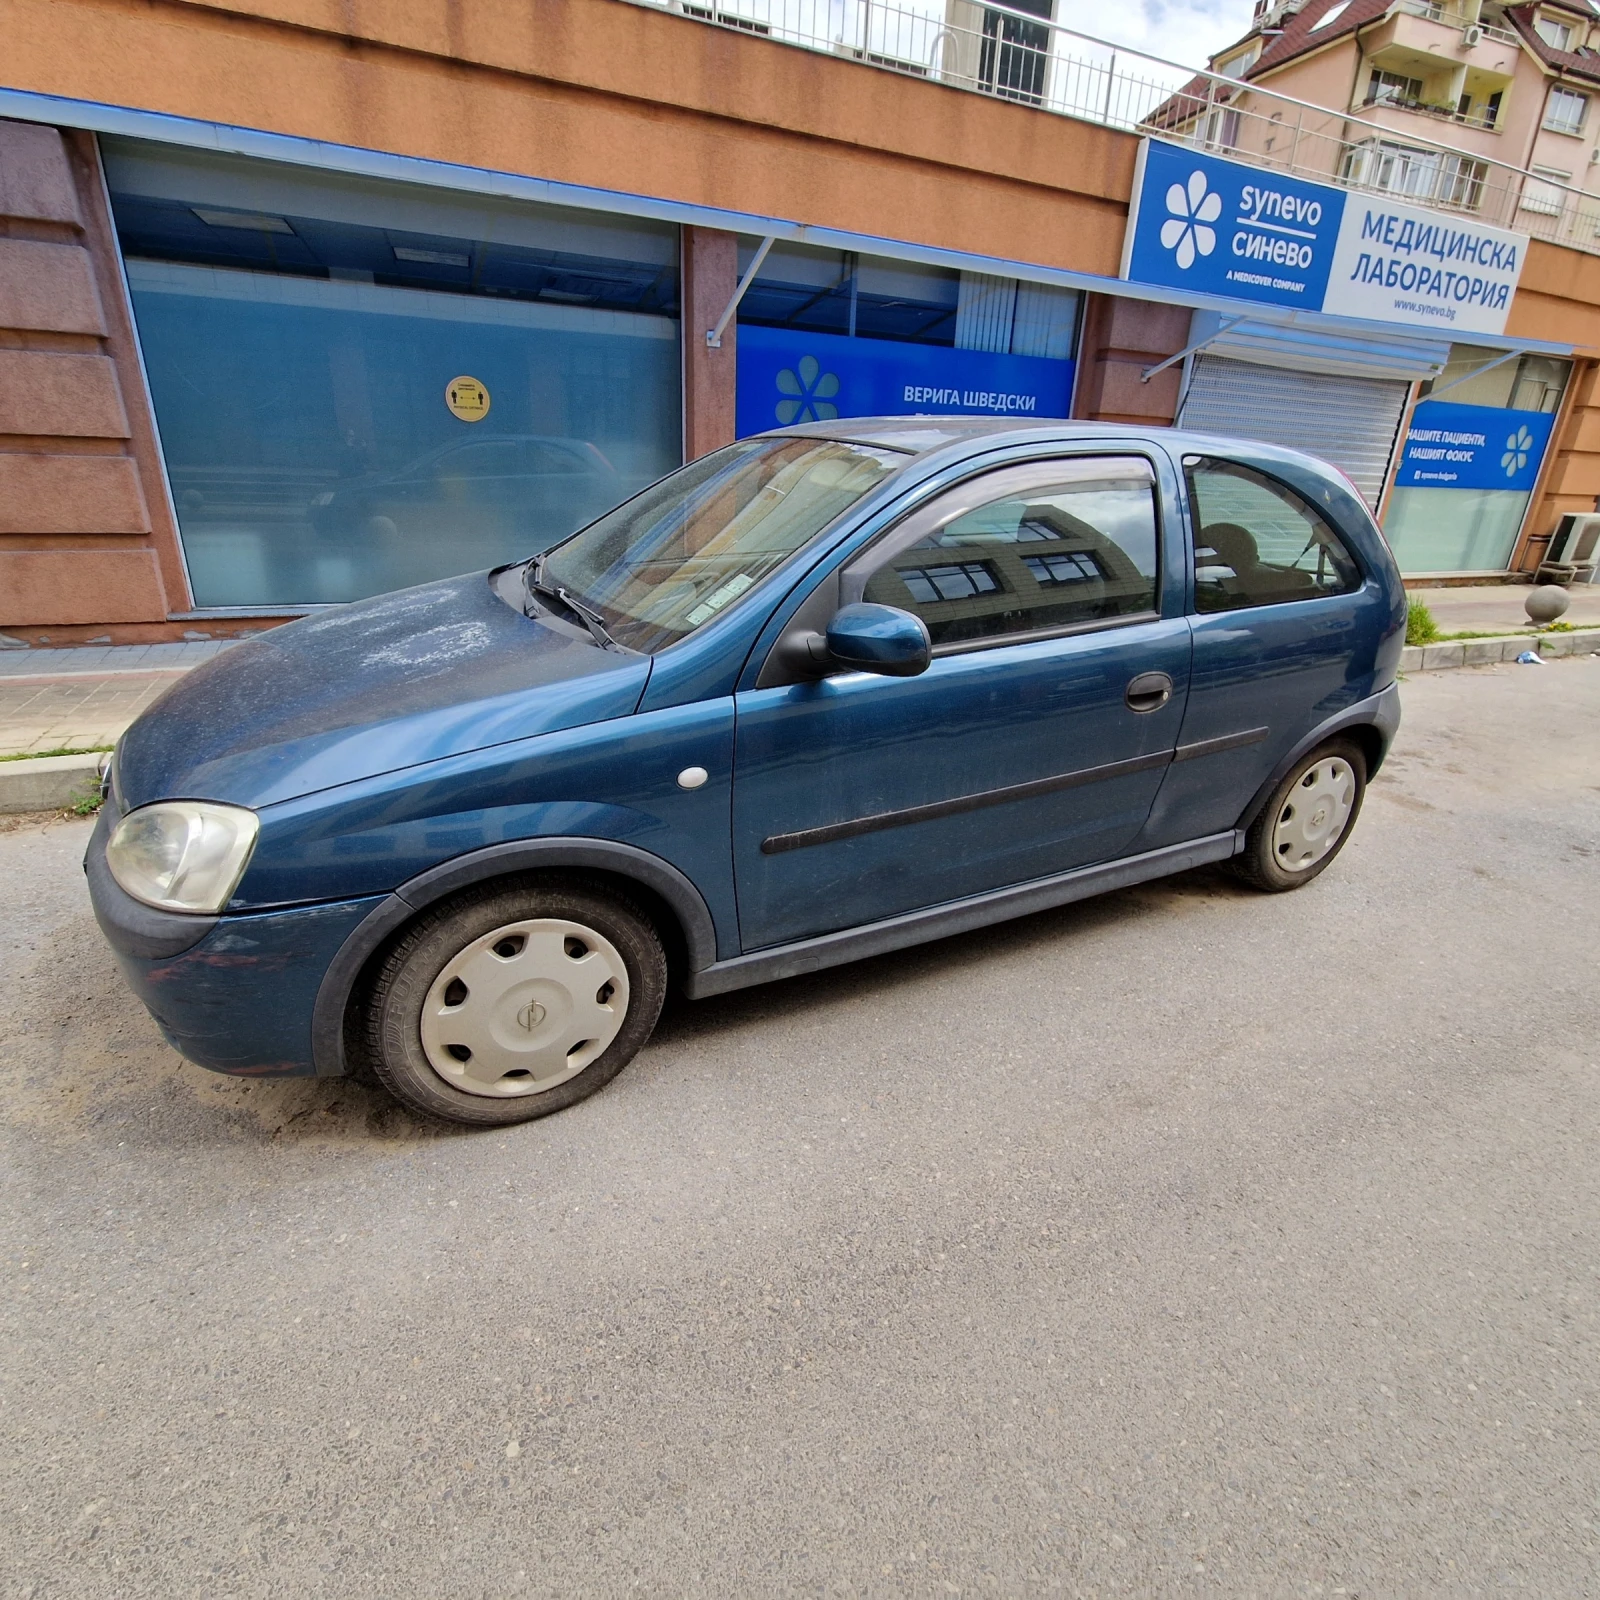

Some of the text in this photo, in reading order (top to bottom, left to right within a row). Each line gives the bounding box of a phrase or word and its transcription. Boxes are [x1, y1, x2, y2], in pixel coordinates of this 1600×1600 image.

[1239, 185, 1322, 226] synevo
[1361, 210, 1516, 273] МЕДИЦИНСКА
[1226, 270, 1306, 293] A MEDICOVER COMPANY
[1350, 253, 1510, 310] ЛАБОРАТОРИЯ
[1394, 299, 1456, 321] www.synevo.bg
[904, 385, 1036, 412] ВЕРИГА ШВЕДСКИ
[1406, 428, 1486, 447] НАШИТЕ ПАЦИЕНТИ,
[1409, 446, 1475, 463] НАШИЯТ ФОКУС
